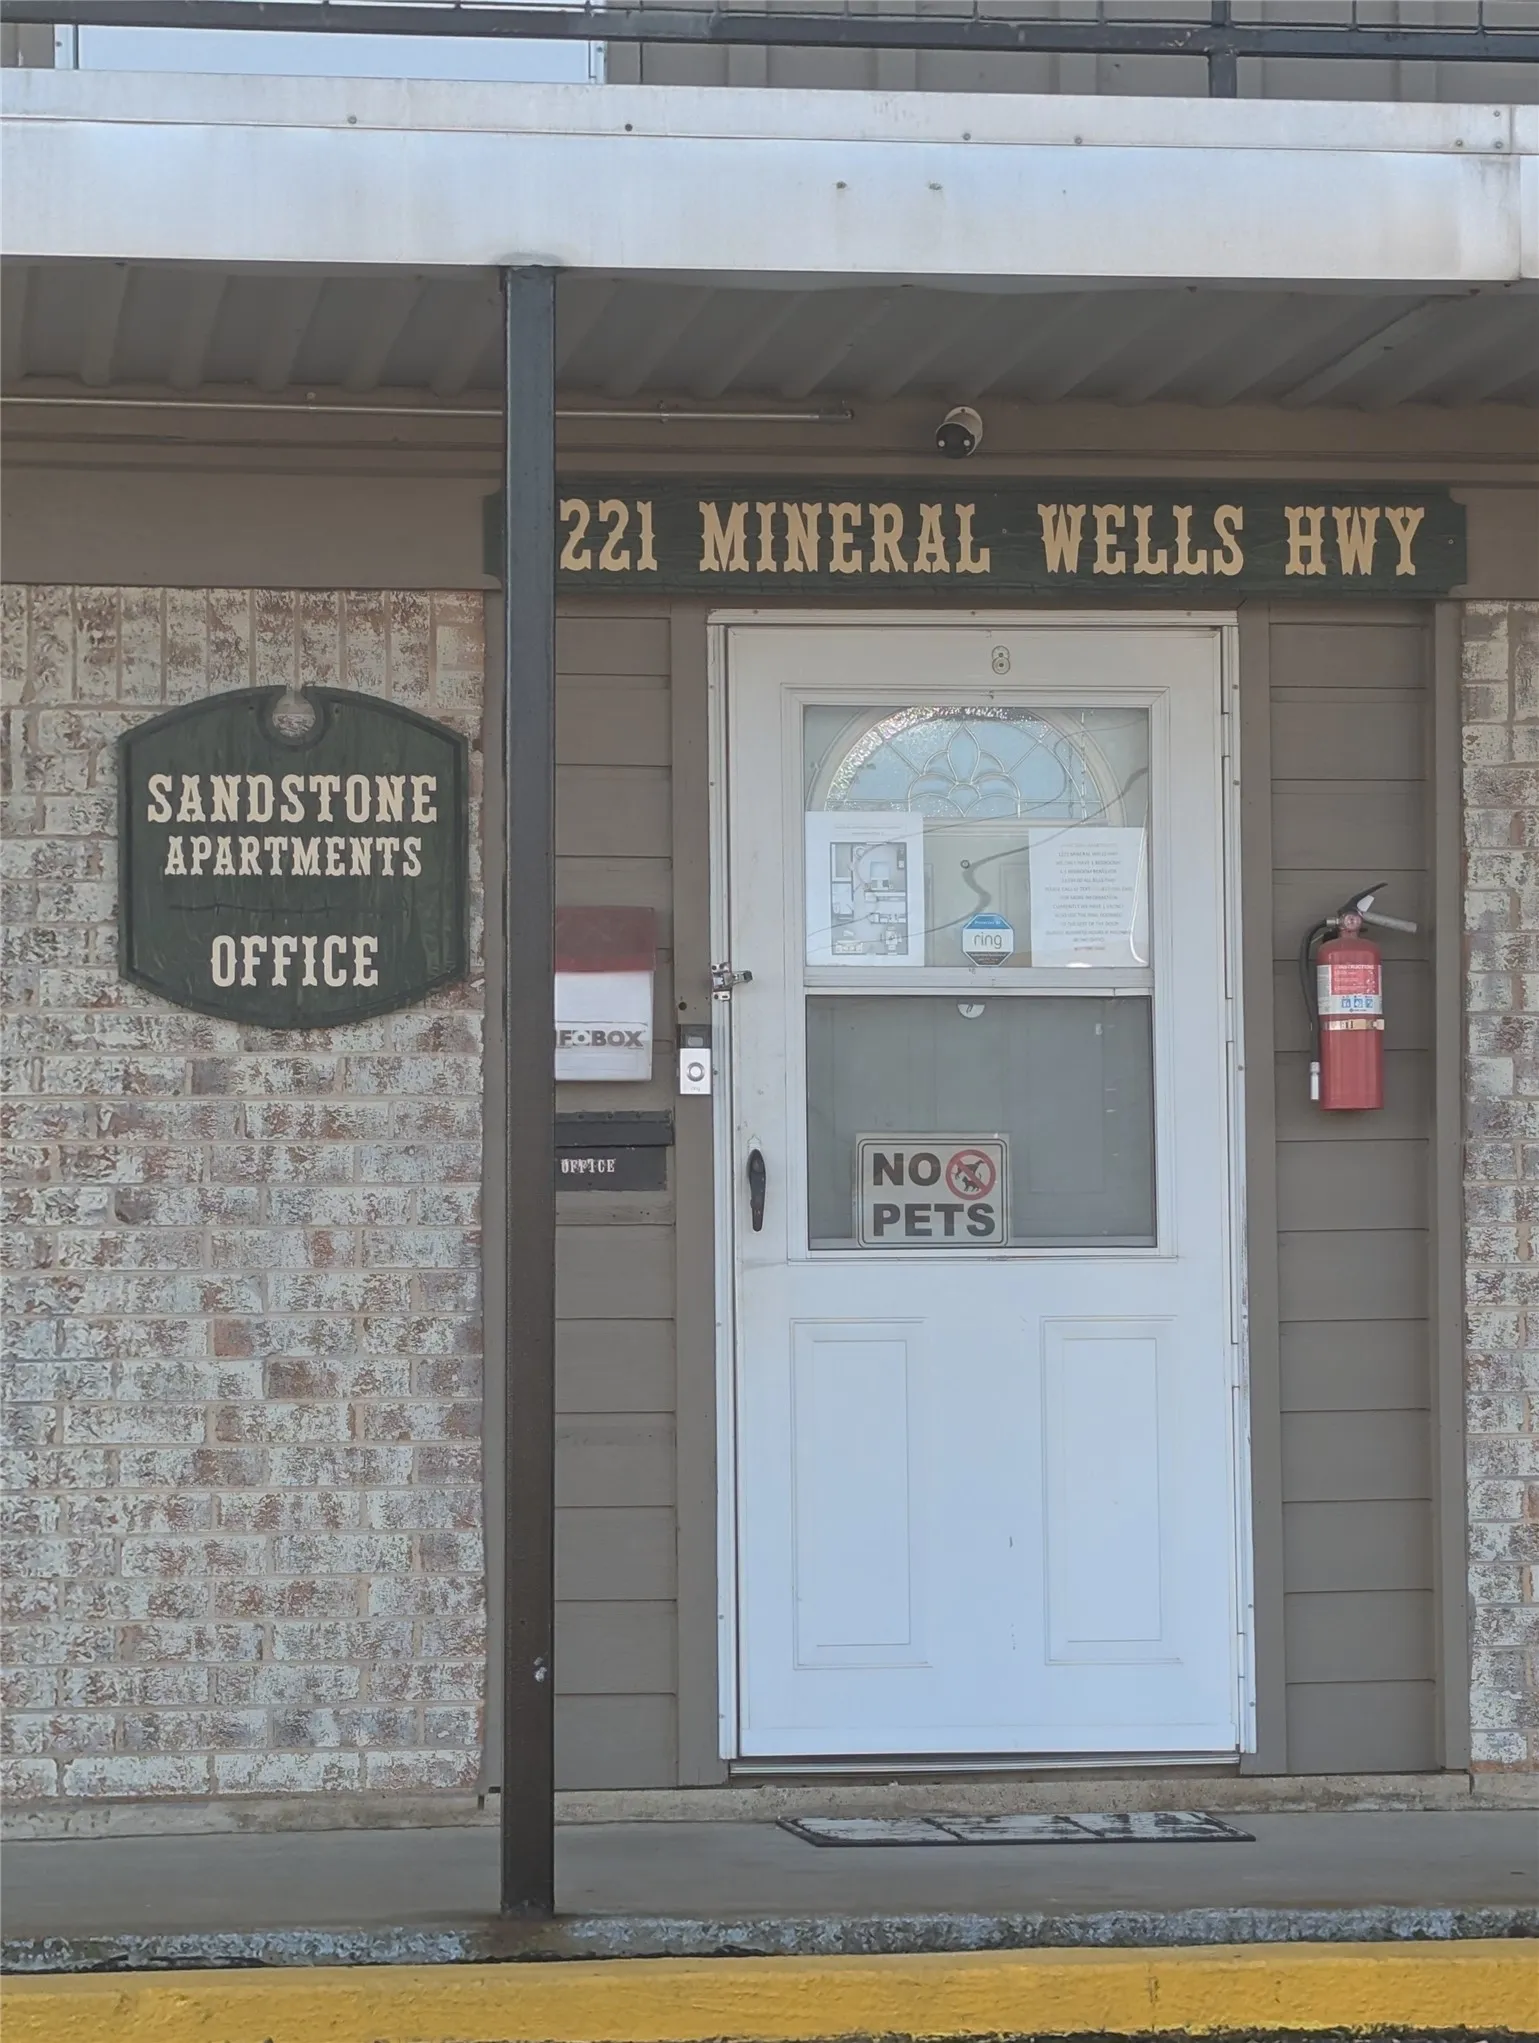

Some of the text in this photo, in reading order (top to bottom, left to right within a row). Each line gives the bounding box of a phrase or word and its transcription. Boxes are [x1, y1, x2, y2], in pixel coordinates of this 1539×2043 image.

[700, 501, 990, 574] MINERAL
[1037, 503, 1244, 576] WELLS
[1285, 505, 1425, 576] HWY
[148, 773, 438, 824] SANDSTONE
[164, 835, 422, 877] APARTMENTS
[974, 931, 1002, 950] ring
[210, 935, 379, 987] OFFICE
[561, 1158, 616, 1174] OFFICE
[873, 1152, 942, 1186] NO
[873, 1203, 996, 1237] PETS
